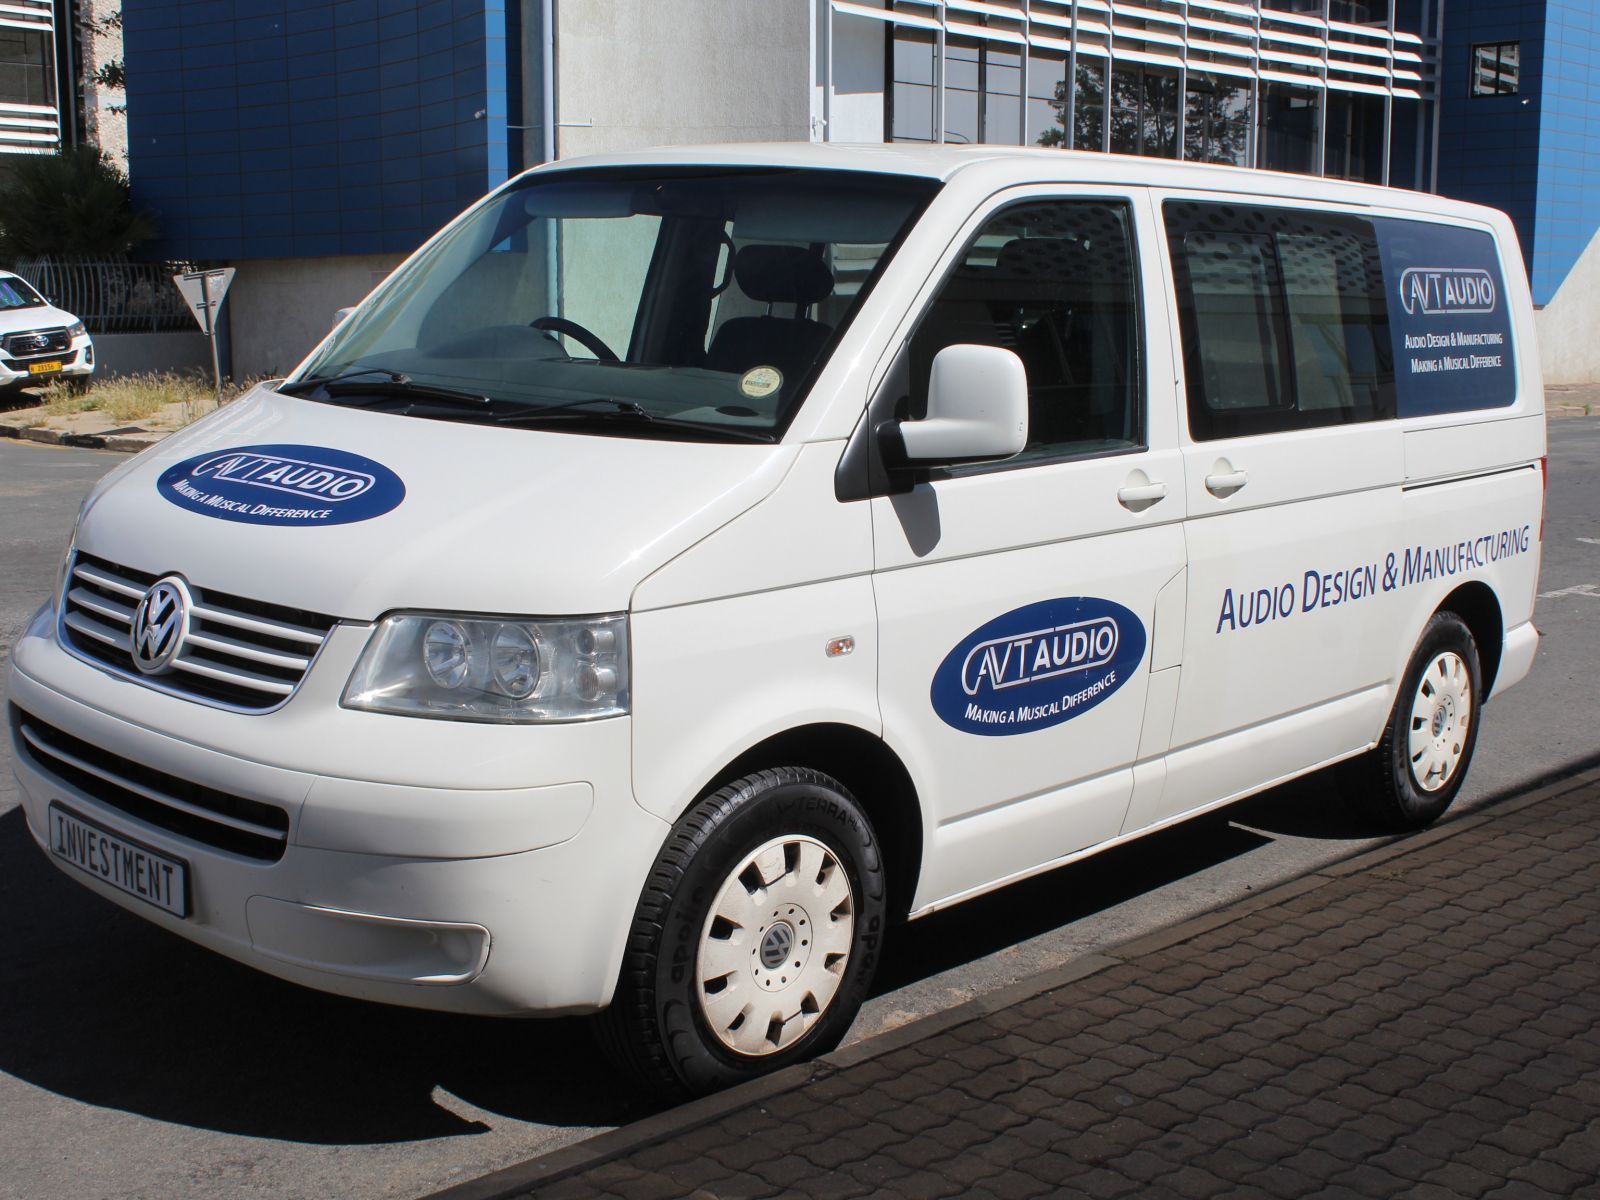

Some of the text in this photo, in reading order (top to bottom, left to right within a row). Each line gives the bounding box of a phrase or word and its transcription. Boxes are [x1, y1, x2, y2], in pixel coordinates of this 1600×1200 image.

[1405, 331, 1503, 349] AUDIO DESIGN & MANUFACTURING
[1411, 354, 1502, 374] MAKING A MUSICAL DIFFERENCE
[172, 478, 333, 519] MAKING A MUSICAL DIFFERENCE
[1216, 525, 1530, 634] AUDIO DESIGN & MANUFACTURING
[965, 670, 1116, 723] MAKING A MUSICAL DIFFERENCE
[58, 816, 173, 906] INVESTMENT
